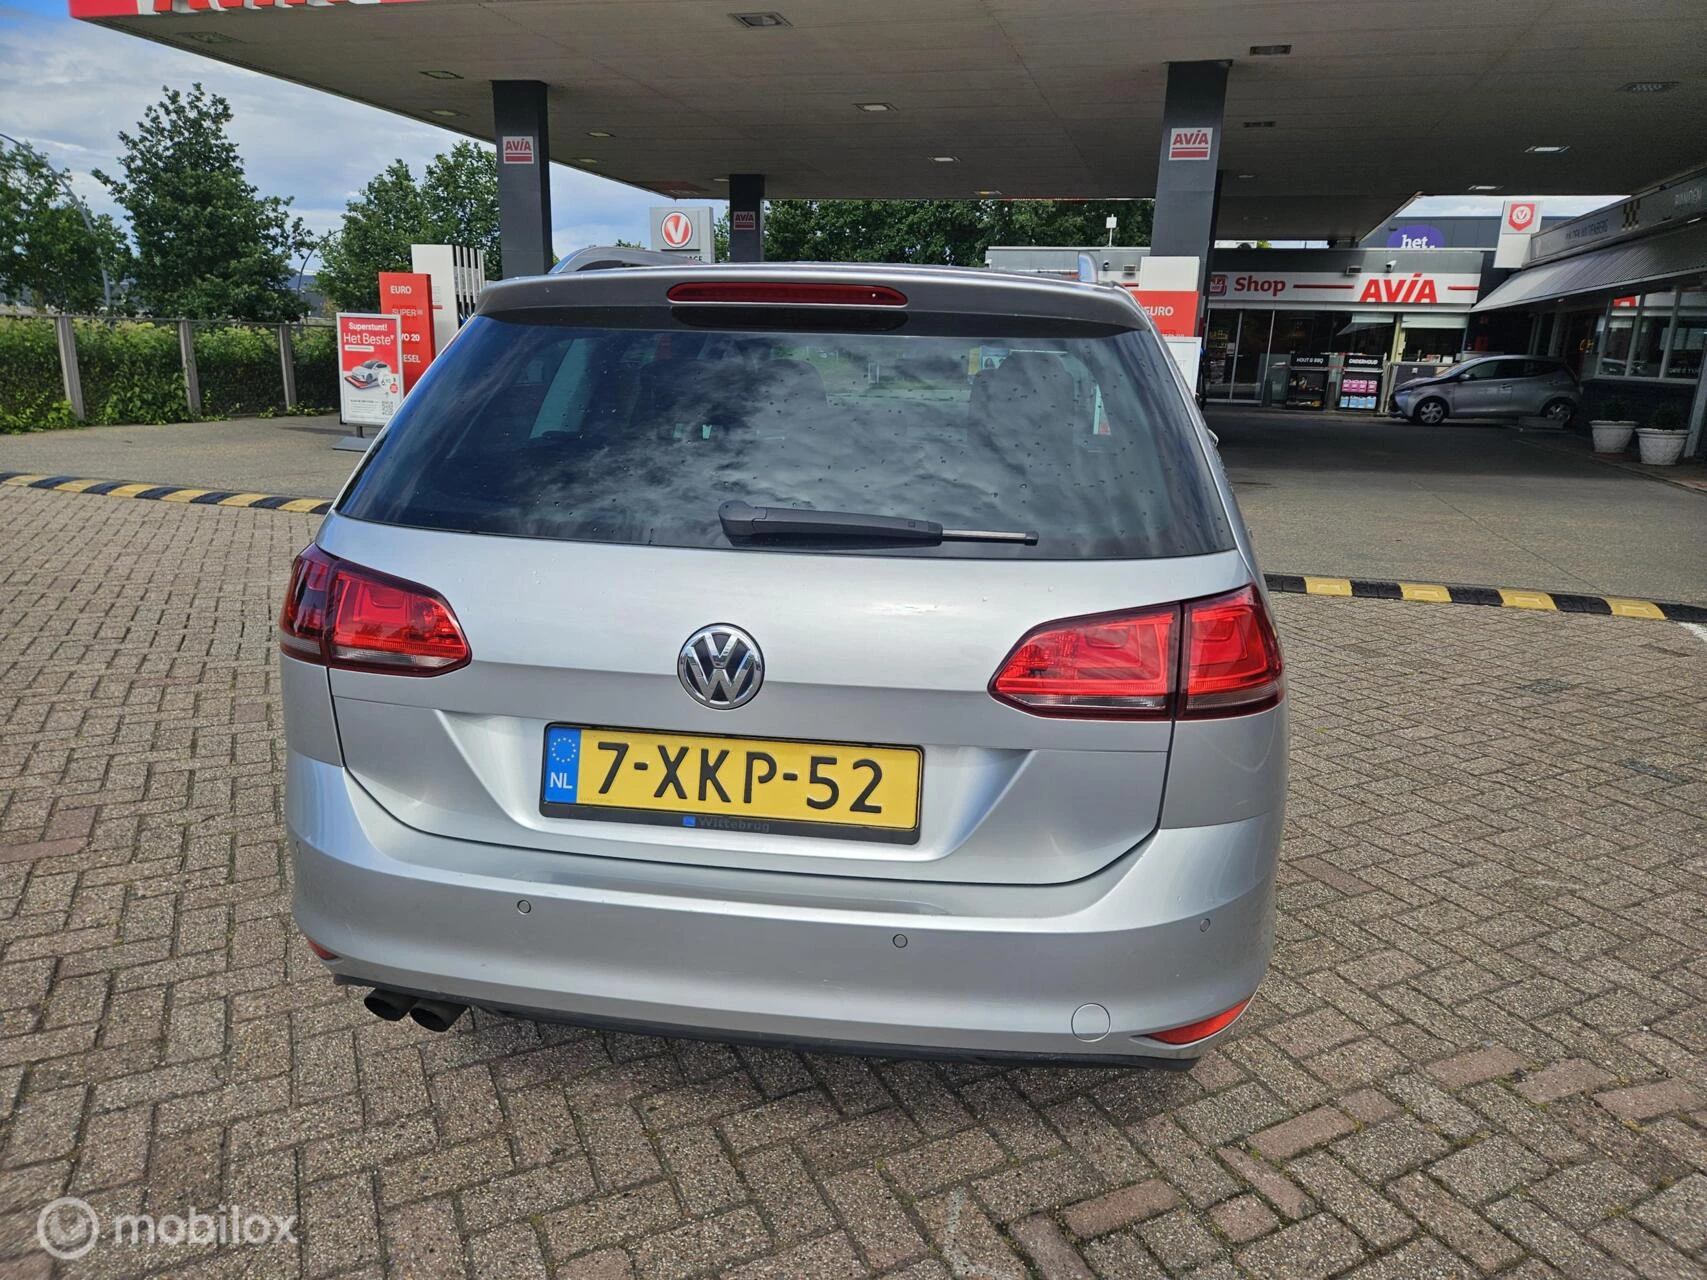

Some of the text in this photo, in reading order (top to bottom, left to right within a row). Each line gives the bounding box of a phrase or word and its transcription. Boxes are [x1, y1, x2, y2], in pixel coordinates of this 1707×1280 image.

[390, 285, 412, 295] EURO
[1234, 275, 1286, 297] Shop
[343, 332, 361, 344] Het
[403, 354, 421, 363] ESEL
[549, 772, 573, 790] NL
[597, 741, 883, 814] 7-XKP-52
[699, 815, 770, 834] Wittebrug
